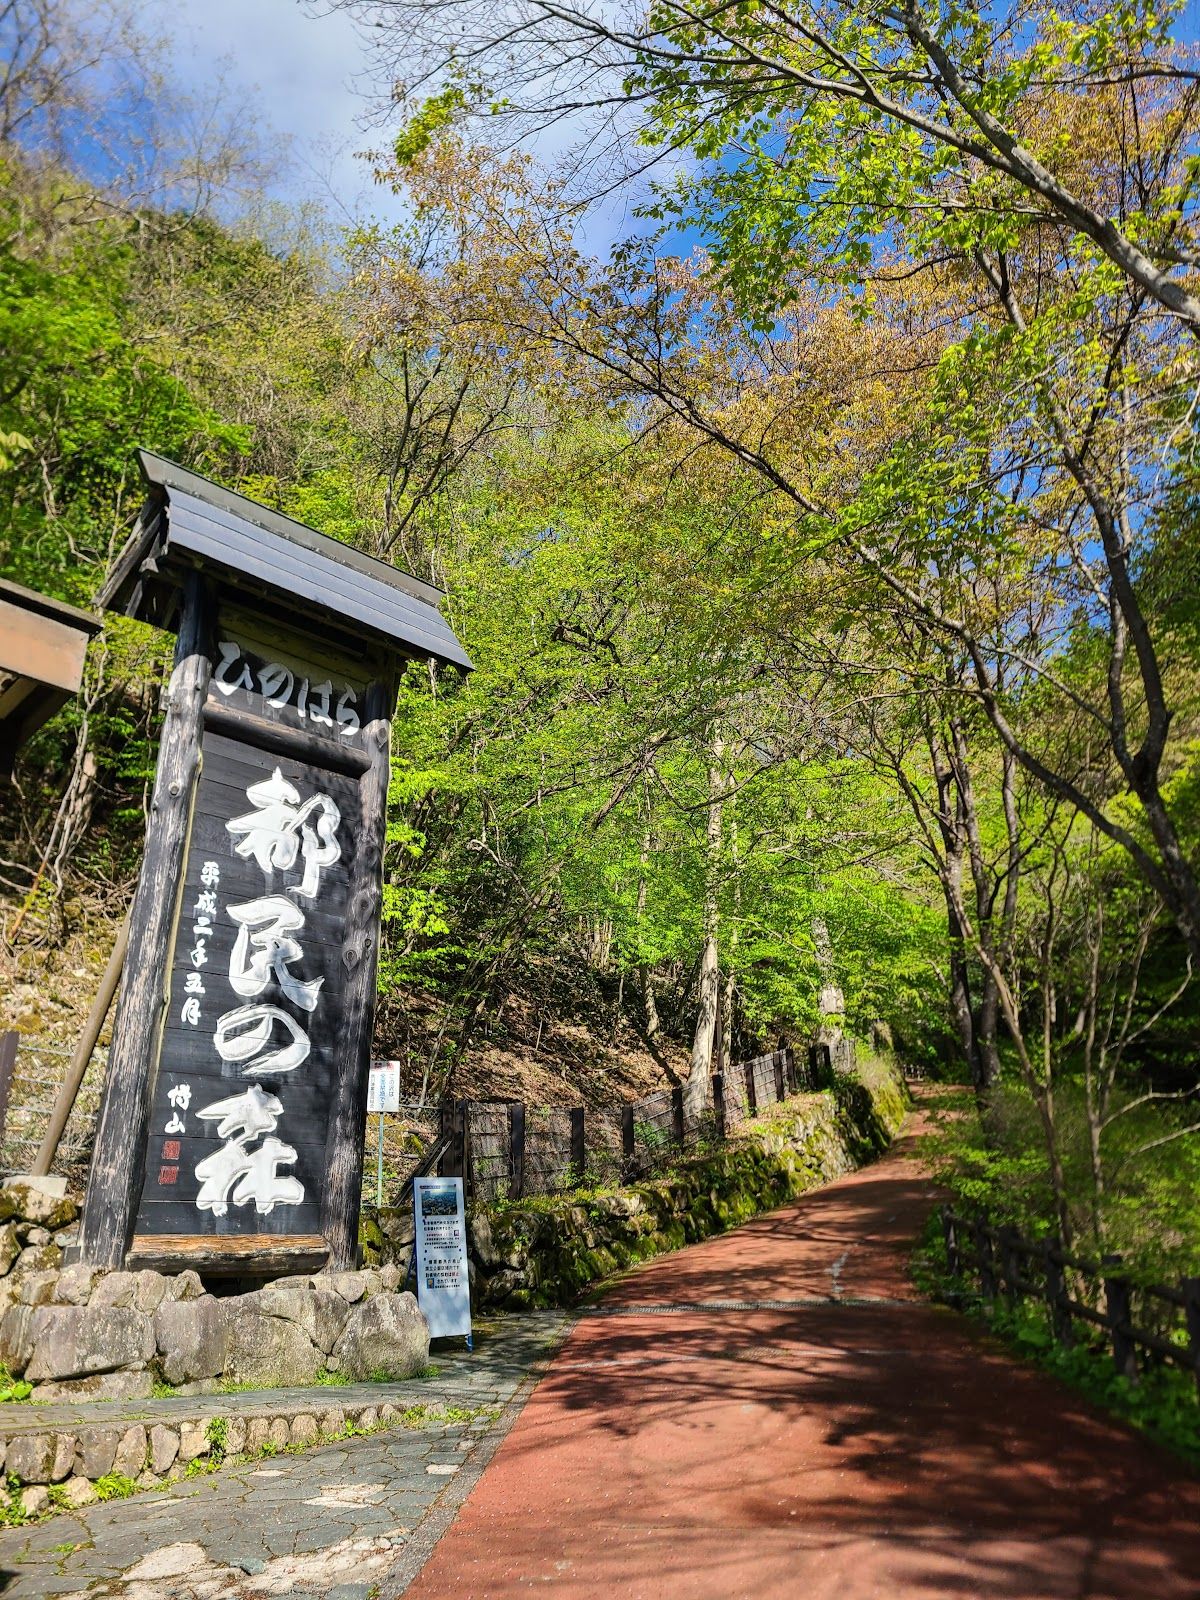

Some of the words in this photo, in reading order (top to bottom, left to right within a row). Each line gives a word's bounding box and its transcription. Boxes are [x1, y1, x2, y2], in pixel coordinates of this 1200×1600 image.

[214, 641, 361, 736] ひのはら
[195, 766, 342, 1218] 都民の森
